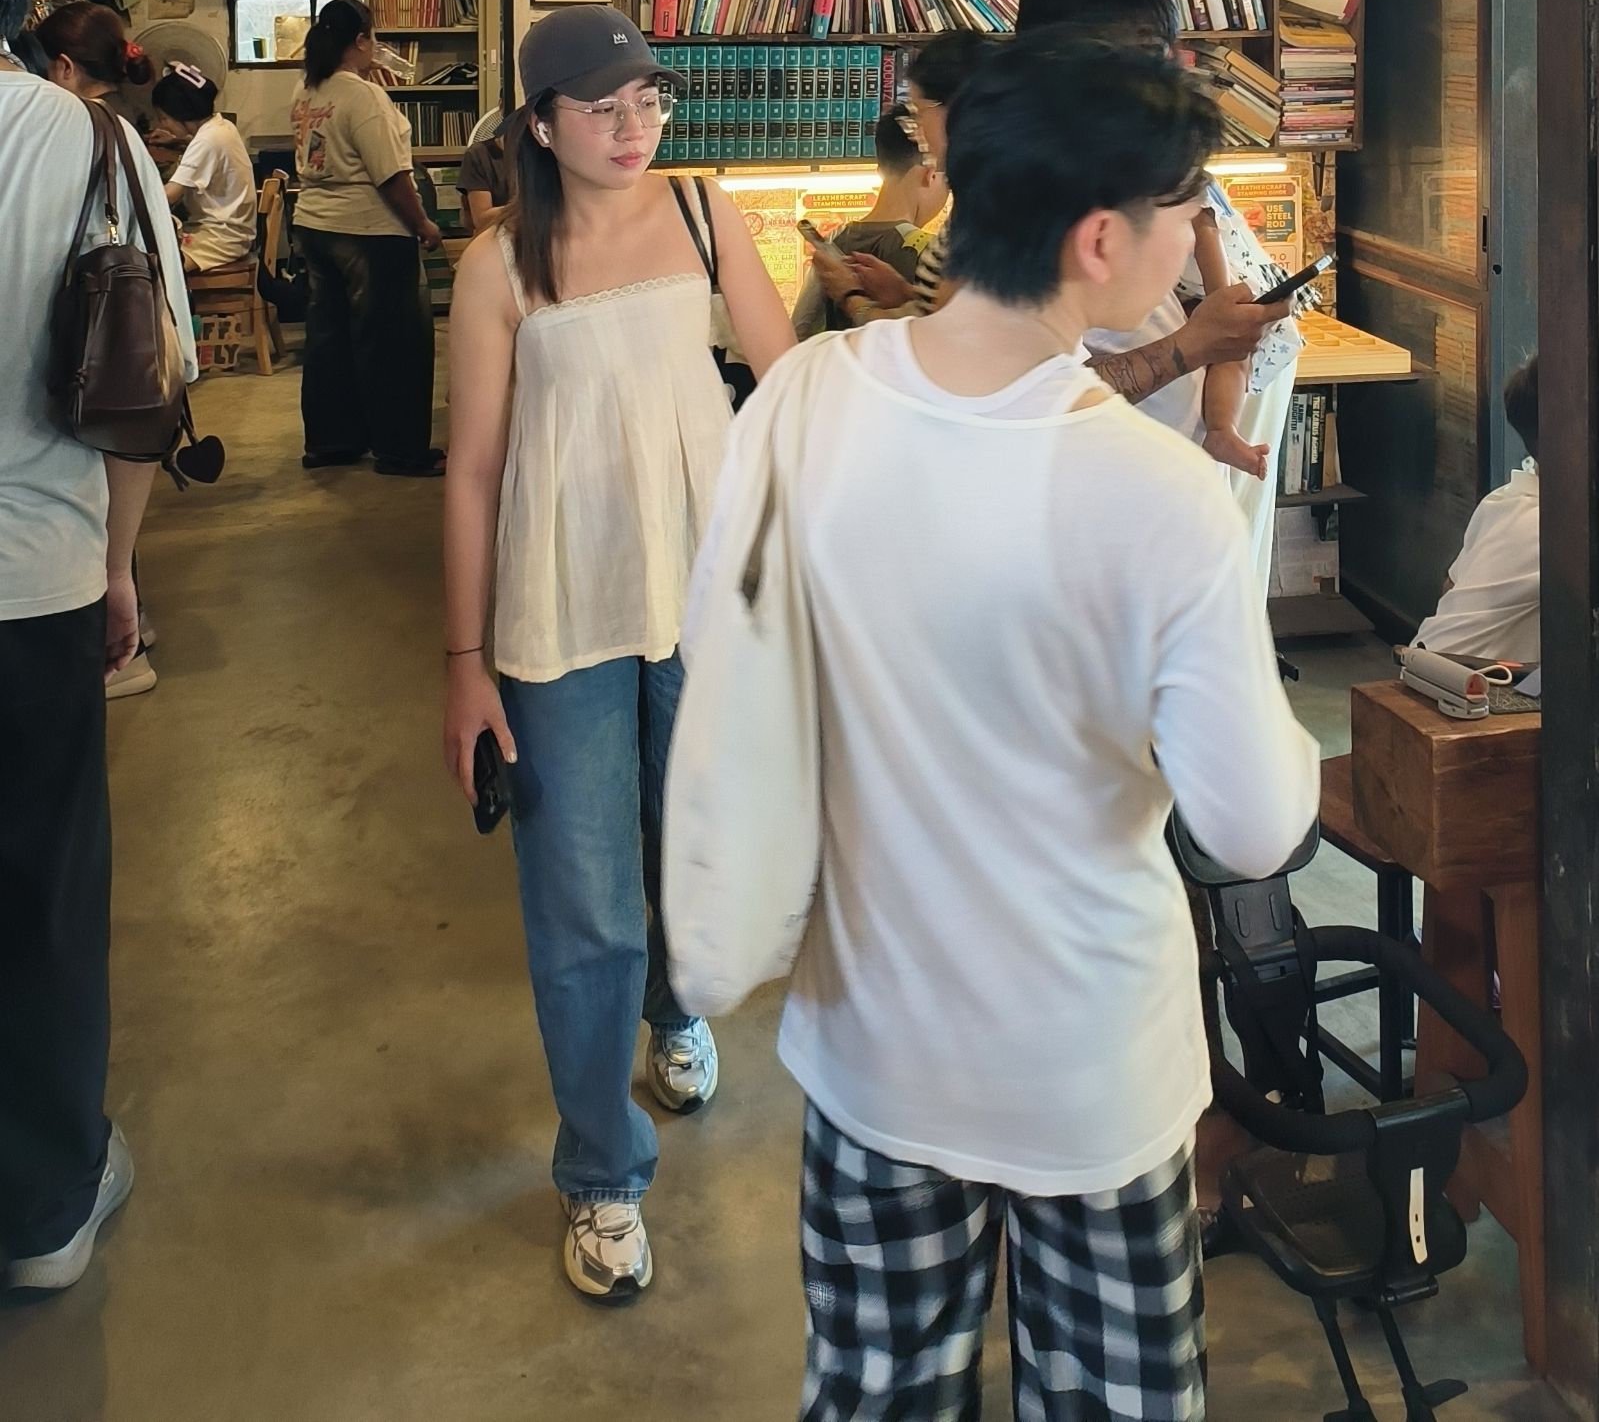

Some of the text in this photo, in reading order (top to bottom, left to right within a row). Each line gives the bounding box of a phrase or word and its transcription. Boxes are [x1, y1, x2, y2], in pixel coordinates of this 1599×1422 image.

[883, 56, 894, 101] KOONTZ
[1266, 204, 1285, 213] USE
[1266, 212, 1293, 220] STEEL
[1266, 221, 1286, 229] ROD
[1290, 396, 1299, 431] SLAUGHTER
[1310, 396, 1321, 464] THE ICARUS AGENDA
